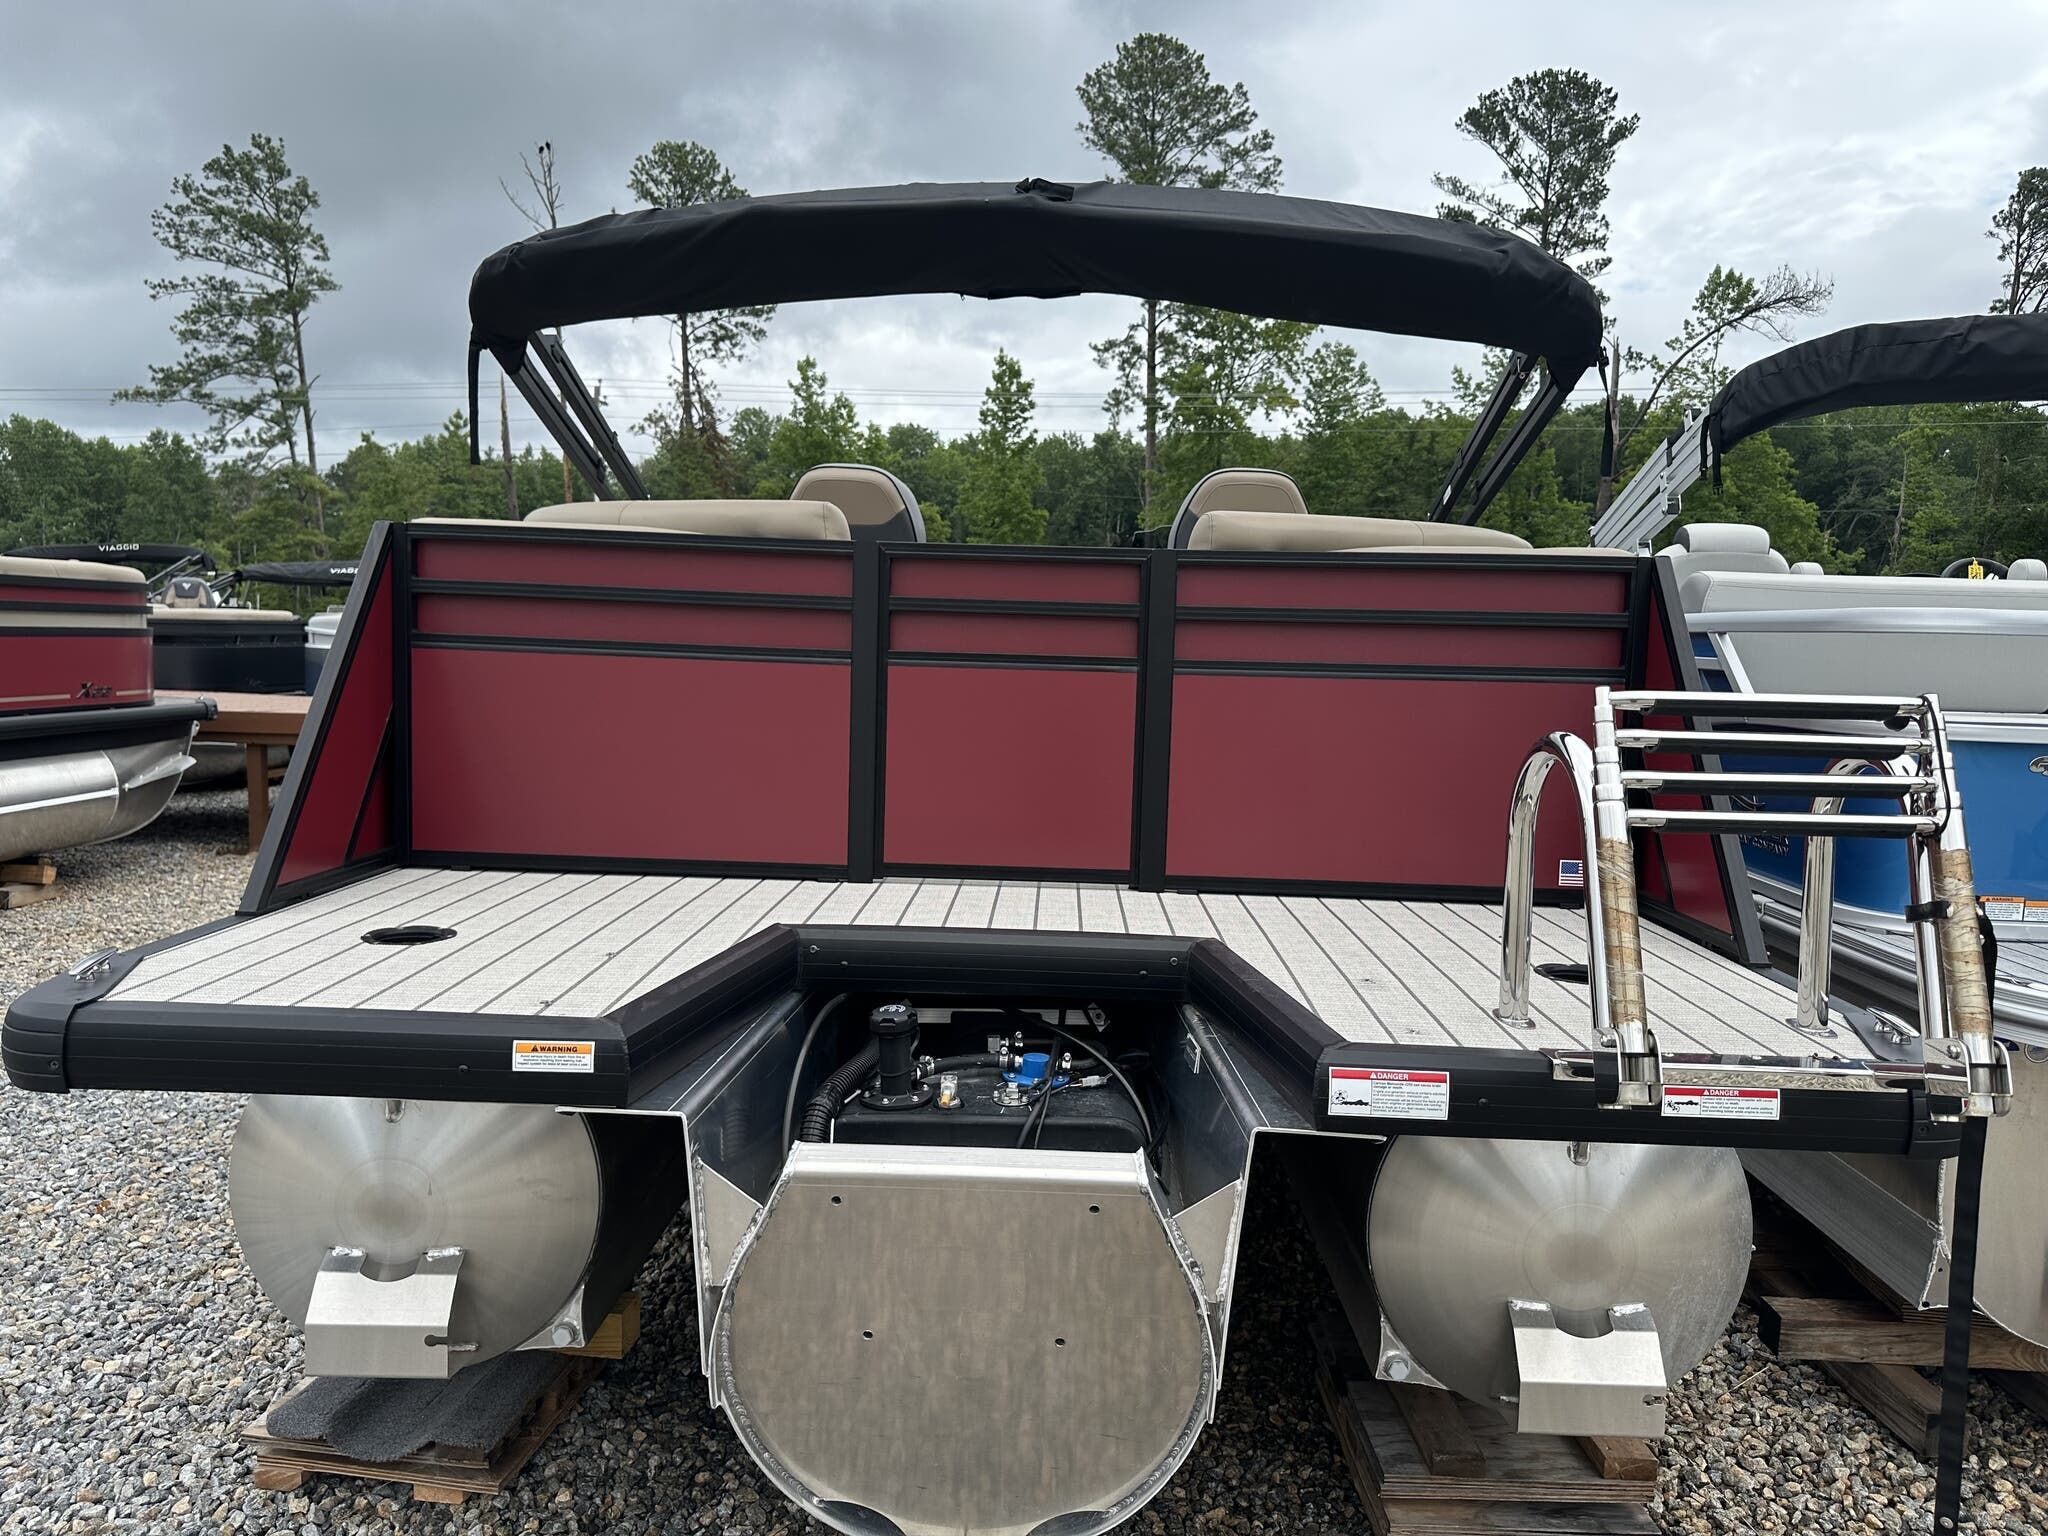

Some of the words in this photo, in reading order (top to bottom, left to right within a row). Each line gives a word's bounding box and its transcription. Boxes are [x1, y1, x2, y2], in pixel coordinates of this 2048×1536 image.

[98, 543, 140, 552] VIAGGIO
[1377, 1072, 1409, 1081] DANGER
[1709, 1089, 1740, 1097] DANGER
